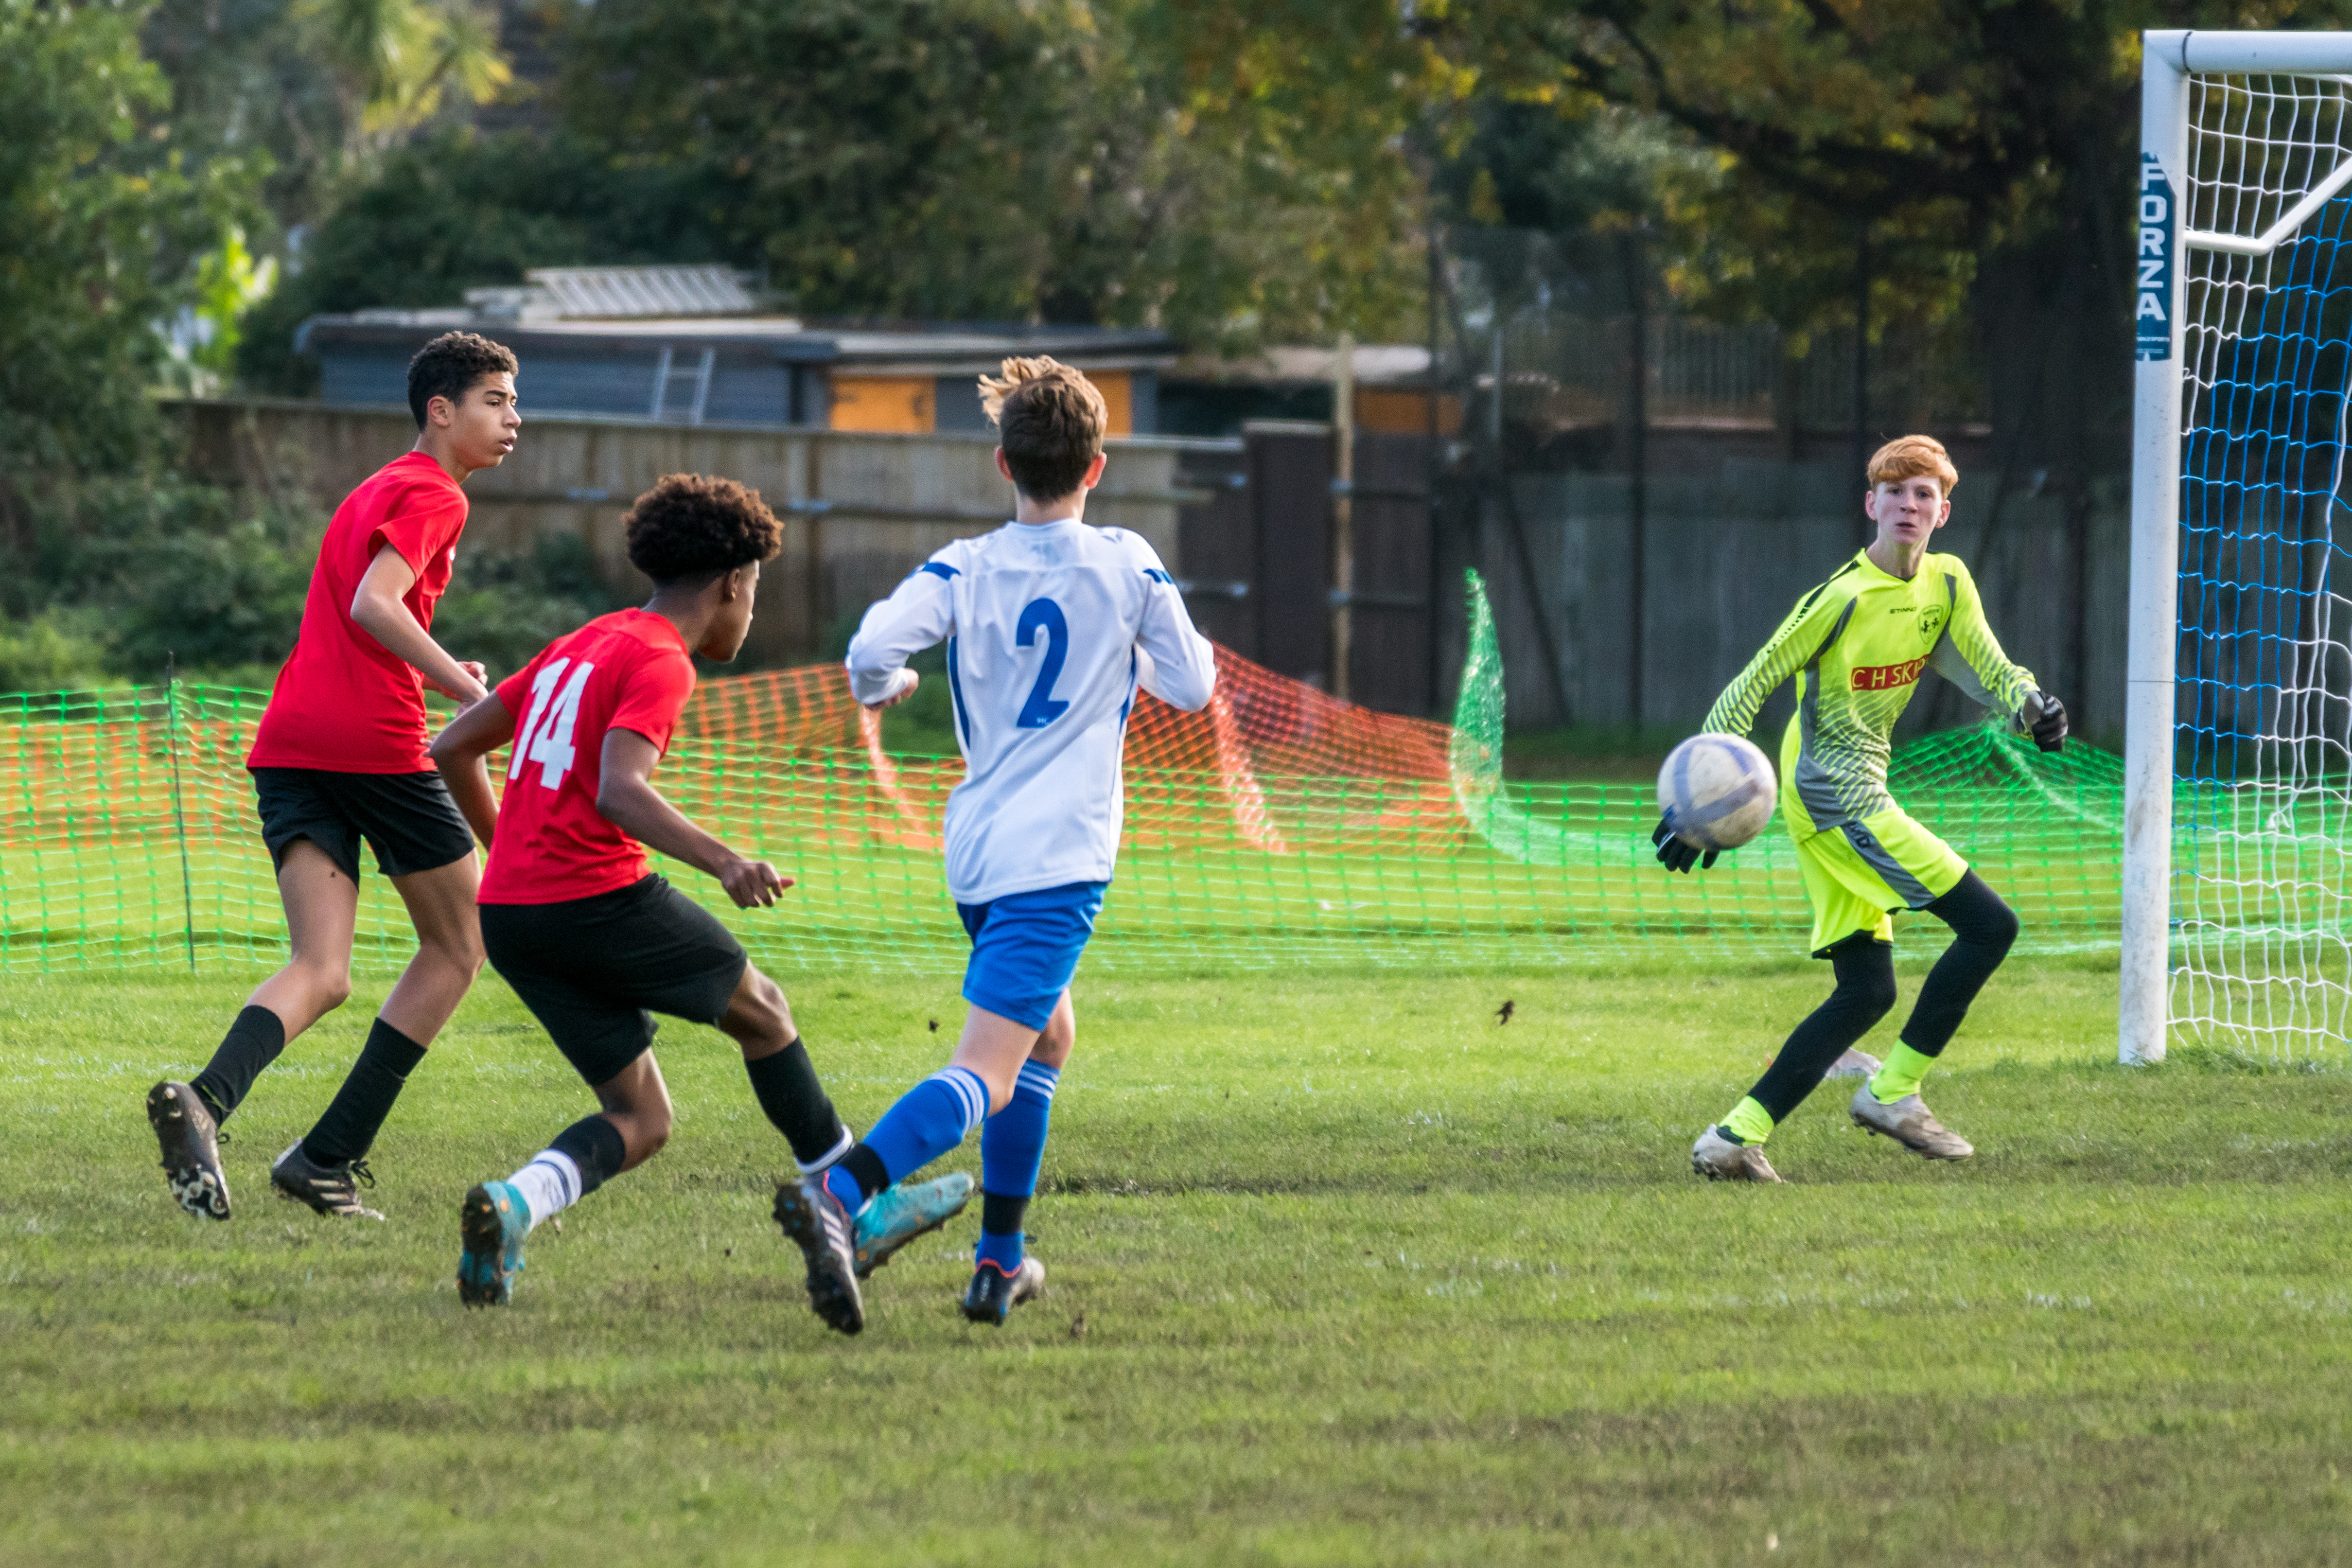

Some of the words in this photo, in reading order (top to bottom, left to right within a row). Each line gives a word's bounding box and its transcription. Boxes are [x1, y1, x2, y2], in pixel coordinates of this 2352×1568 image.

[2136, 163, 2167, 321] FORZA
[508, 657, 595, 791] 14
[1016, 597, 1069, 728] 2
